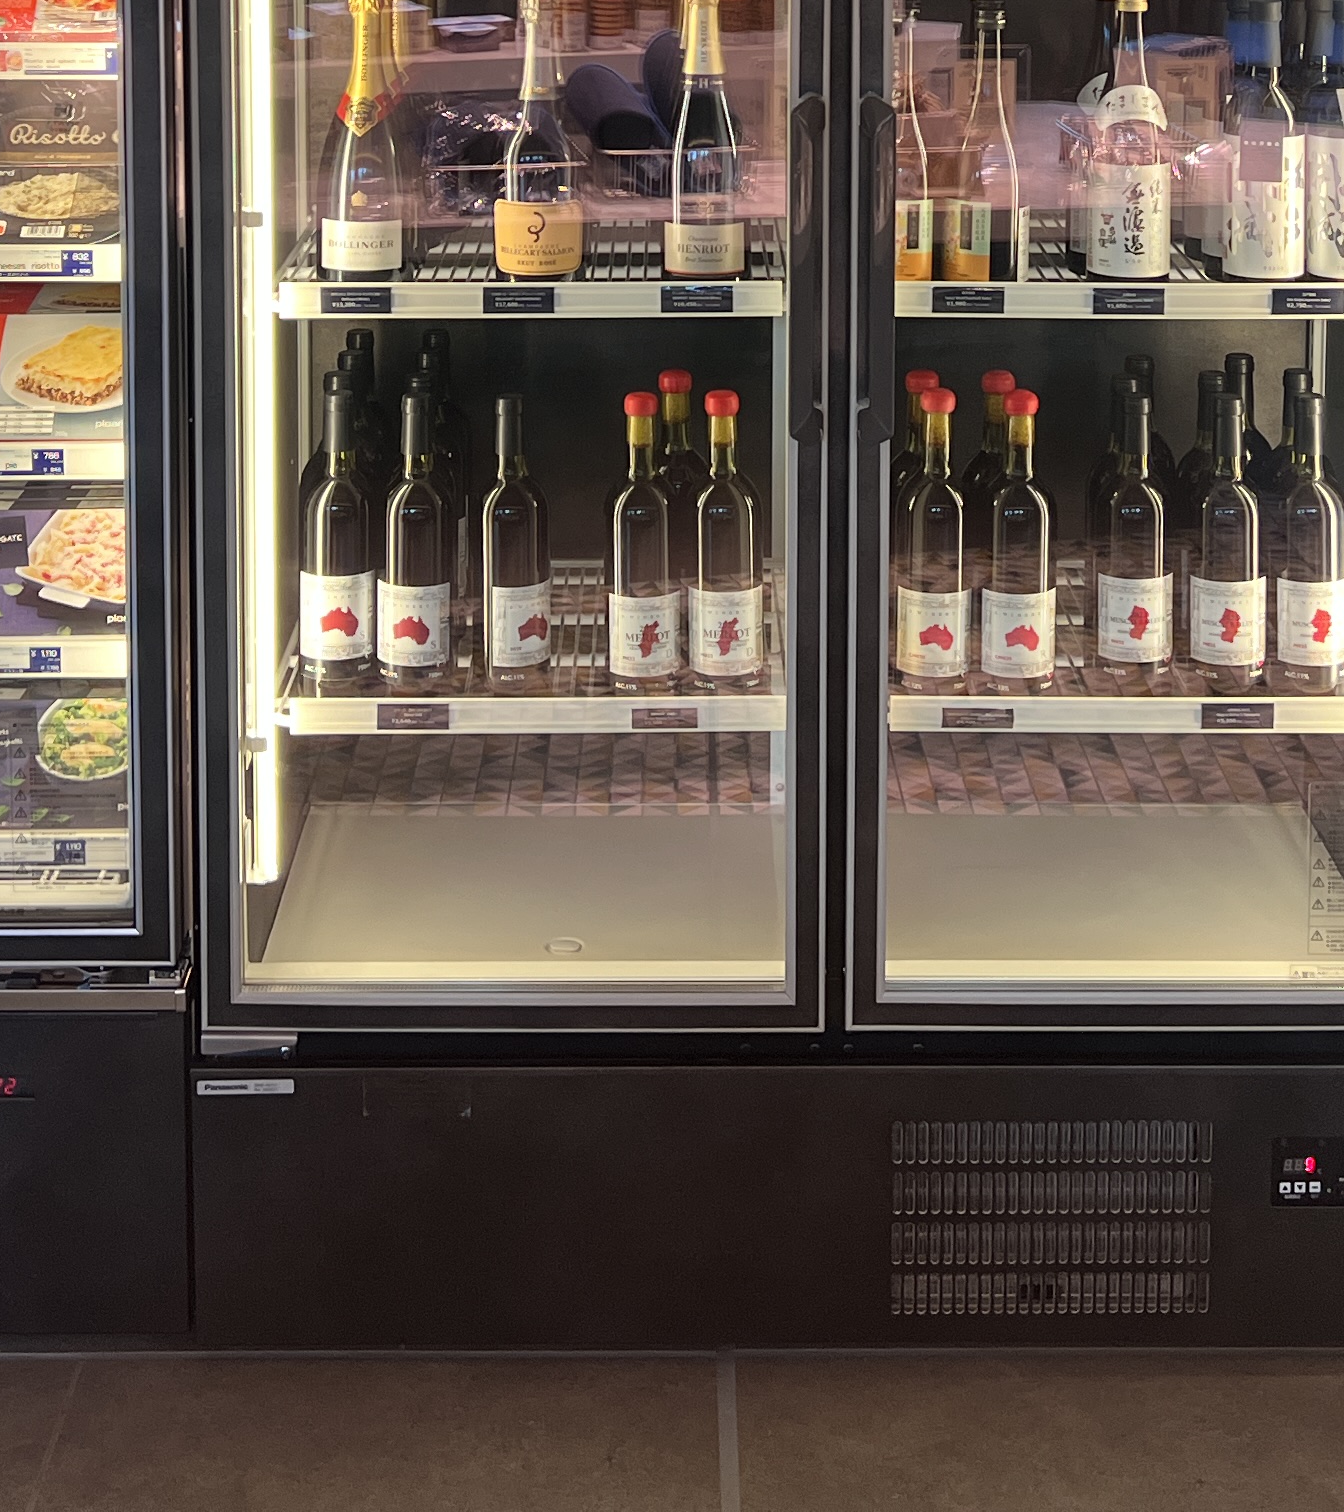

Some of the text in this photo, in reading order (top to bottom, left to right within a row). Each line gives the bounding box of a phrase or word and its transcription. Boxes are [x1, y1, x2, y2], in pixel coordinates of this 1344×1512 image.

[361, 24, 369, 82] BOLLINGER
[10, 123, 106, 146] Risotto
[328, 239, 394, 249] BOLLINGER
[677, 243, 730, 255] HENRIOT
[31, 262, 60, 270] risotto
[5, 461, 17, 471] pie
